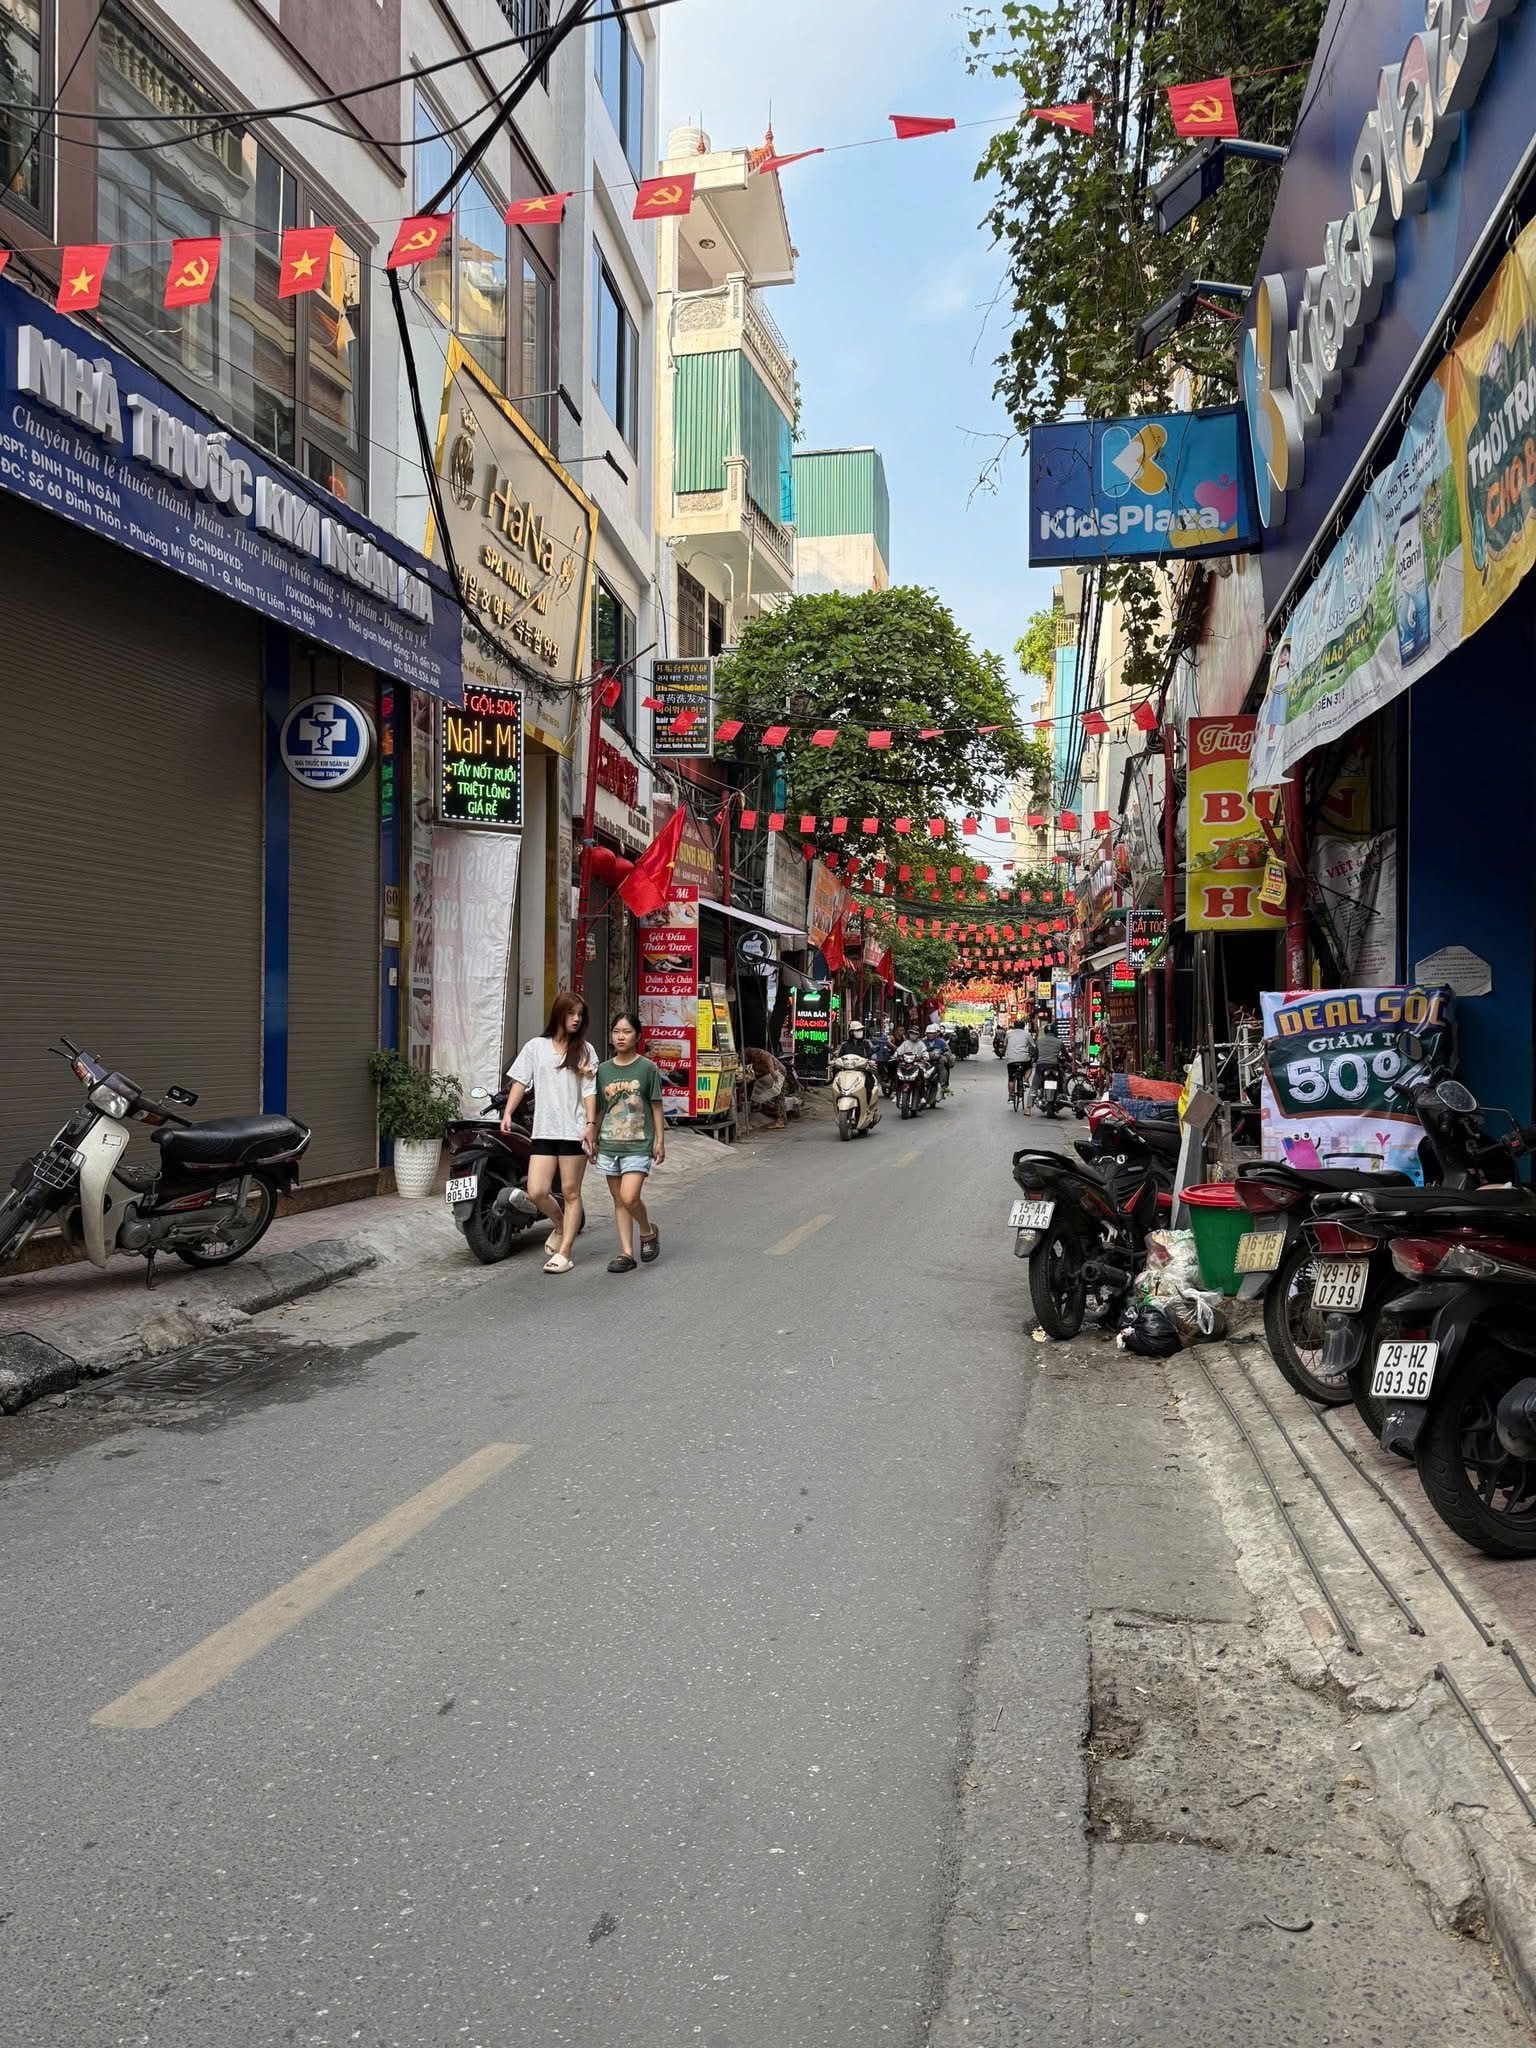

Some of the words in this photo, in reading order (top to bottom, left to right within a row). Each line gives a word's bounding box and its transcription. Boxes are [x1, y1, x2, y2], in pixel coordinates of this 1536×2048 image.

[1468, 409, 1508, 488] THỜI
[18, 324, 123, 444] NHÀ
[127, 393, 253, 516] THUỐC
[256, 476, 320, 558] KIM
[321, 517, 398, 604] NGÂN
[32, 450, 62, 478] ĐINH
[65, 467, 84, 493] THỊ
[87, 478, 120, 509] NGÂN
[1487, 455, 1523, 528] CHO
[13, 405, 72, 454] Chuyên
[75, 442, 100, 470] bán
[104, 455, 117, 479] lẻ
[119, 466, 154, 500] thuốc
[158, 490, 196, 521] thành
[194, 509, 224, 539] phẩm
[234, 527, 259, 560] Thực
[262, 548, 288, 574] phẩm
[290, 559, 312, 586] chức
[313, 576, 334, 602] năng
[488, 463, 557, 576] HaNa
[1040, 504, 1219, 540] KidsPlaza
[1, 456, 25, 482] ĐC:
[29, 470, 44, 492] Số
[47, 481, 62, 500] 60
[65, 488, 92, 518] Đình
[94, 503, 121, 531] Thôn
[130, 522, 168, 556] Phường
[170, 542, 184, 564] Mỹ
[187, 551, 208, 574] Đình
[210, 563, 215, 577] 1
[235, 577, 254, 596] Nam
[291, 605, 302, 620] Hà
[303, 611, 316, 629] Nội
[485, 545, 503, 577] SPA
[504, 560, 532, 599] NAILS
[471, 694, 495, 716] GỘI:
[497, 699, 518, 718] 50K
[448, 717, 482, 755] Nail
[496, 723, 516, 759] Mi
[452, 758, 470, 777] TẨY
[473, 762, 491, 779] NỐT
[494, 765, 516, 783] RUỒI
[457, 781, 484, 798] TRIỆT
[485, 786, 511, 799] LÔNG
[468, 799, 484, 814] GIÁ
[485, 802, 498, 816] RẺ
[386, 889, 398, 904] 60
[644, 943, 666, 951] Thảo
[649, 932, 664, 943] Gội
[813, 1010, 827, 1018] BÁN
[1279, 999, 1368, 1036] DEAL
[1380, 987, 1447, 1026] SỐC
[649, 1029, 687, 1039] Body
[1308, 1031, 1374, 1053] GIẢM
[1287, 1048, 1432, 1102] 50%
[668, 1087, 690, 1097] Lông
[447, 1187, 475, 1202] 805.62
[450, 1178, 471, 1190] 29-L1
[1020, 1203, 1047, 1214] 15-AA
[1013, 1215, 1048, 1226] 181.46
[1319, 1285, 1355, 1306] 0799
[1384, 1345, 1428, 1368] 29-H2
[1375, 1371, 1428, 1395] 093.96
